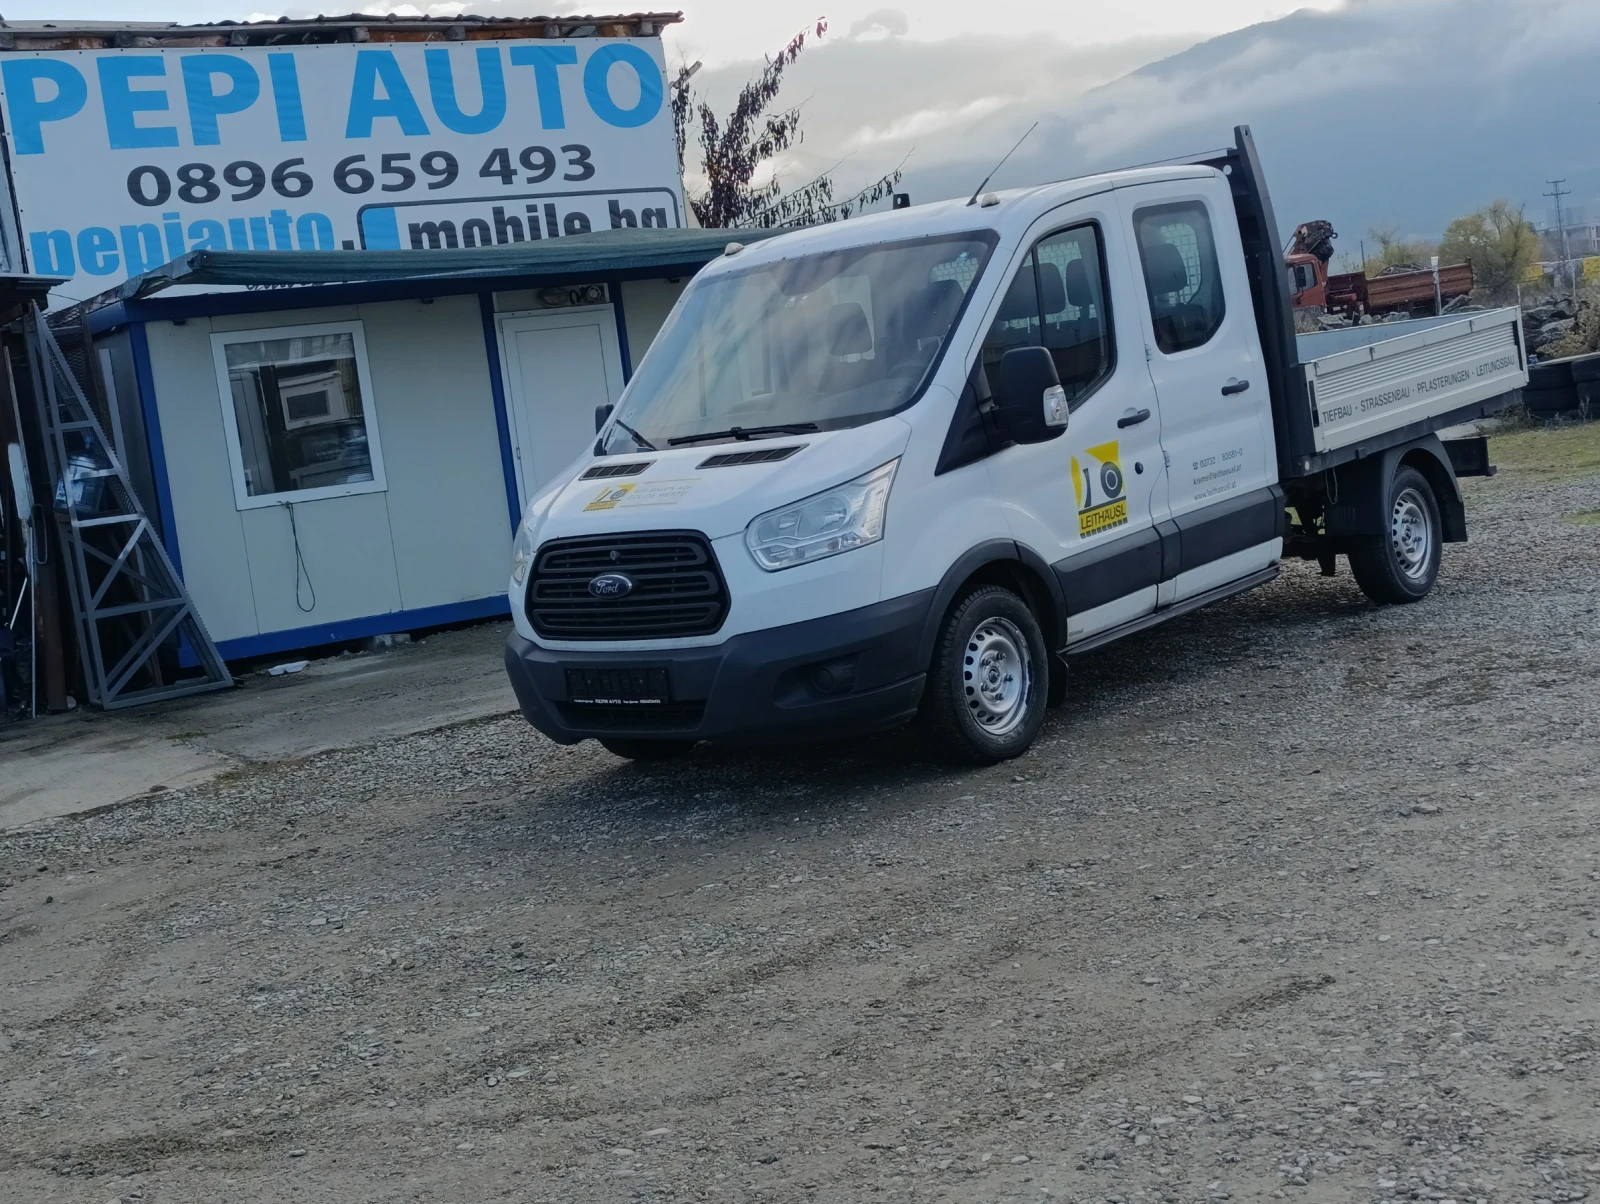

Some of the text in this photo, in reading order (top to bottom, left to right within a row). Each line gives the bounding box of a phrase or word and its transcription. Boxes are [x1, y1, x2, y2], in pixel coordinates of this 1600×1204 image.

[0, 43, 664, 156] PEPI AUTO
[126, 143, 596, 208] 0896 659 493
[1322, 354, 1516, 424] TIEFBAU STRASSENBAU PFLASTERUNGEN LEITUNGSBAU
[1199, 456, 1216, 469] 02732
[1080, 503, 1126, 530] LEITHÄUSL
[595, 579, 620, 594] Ford
